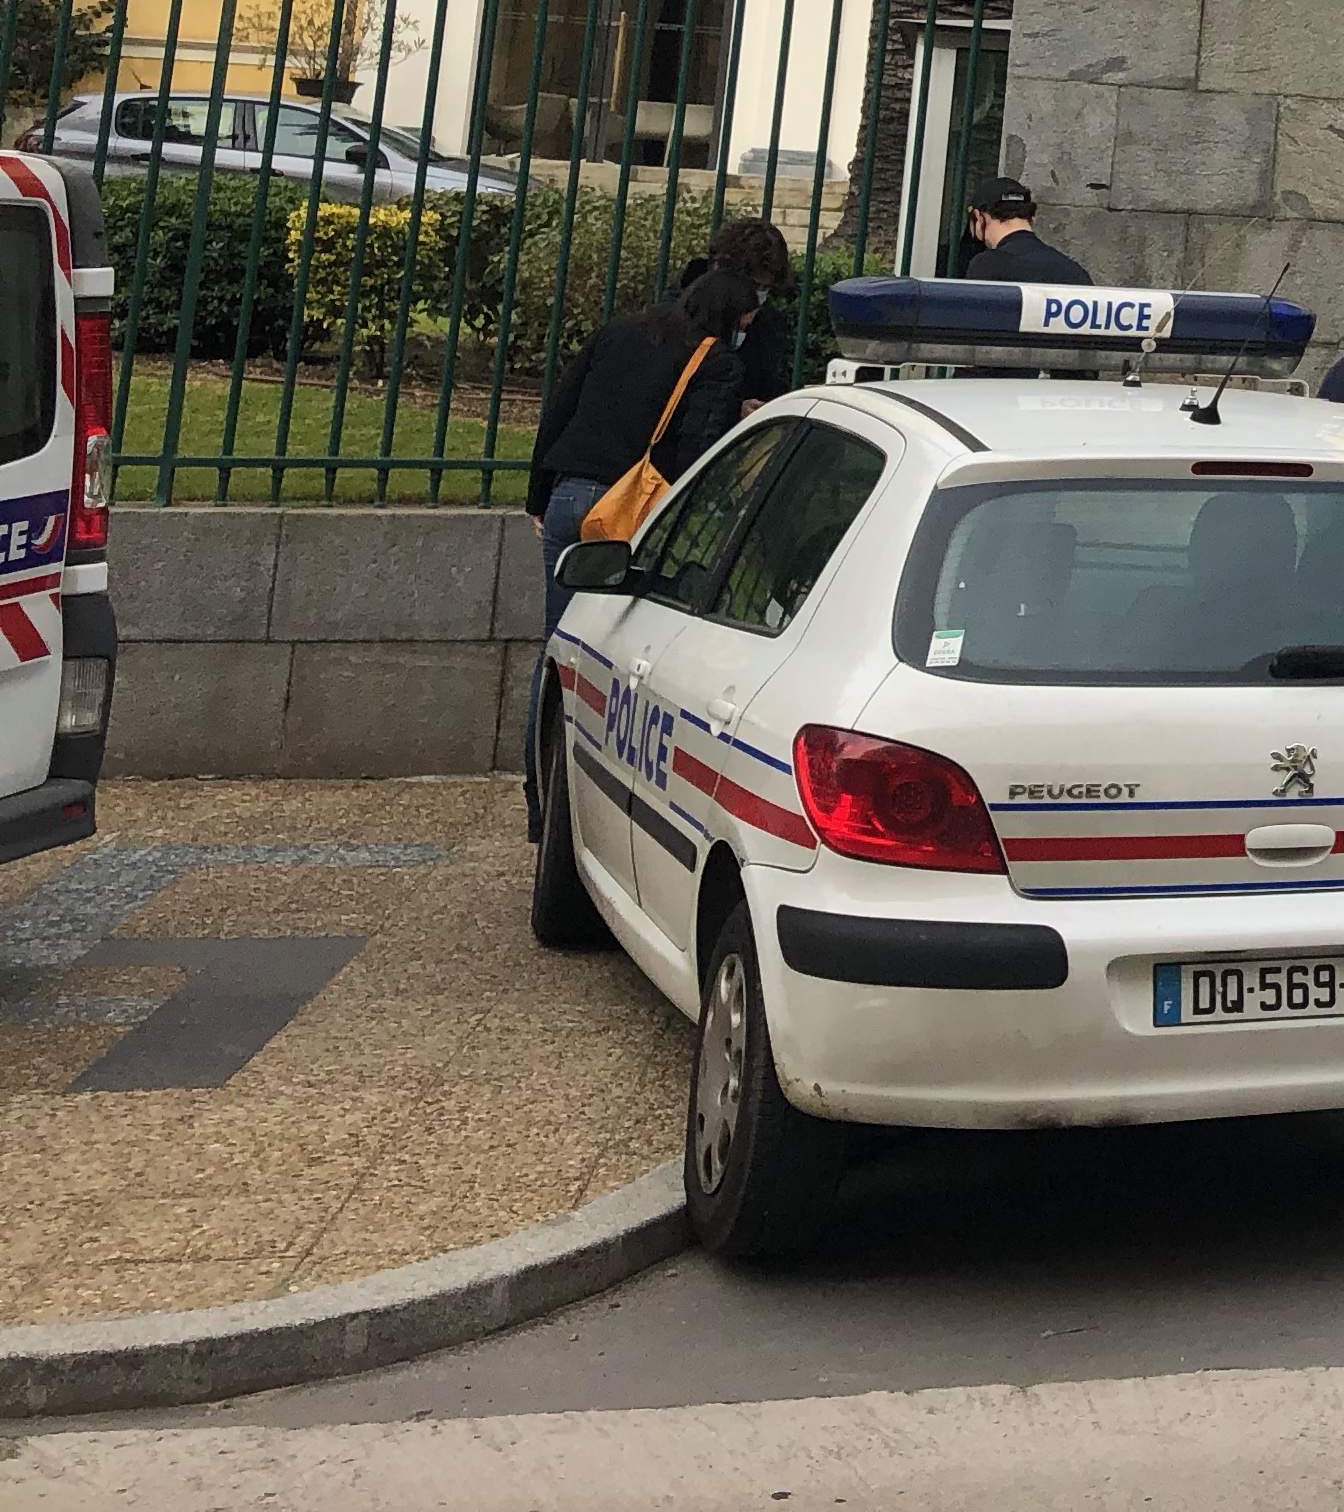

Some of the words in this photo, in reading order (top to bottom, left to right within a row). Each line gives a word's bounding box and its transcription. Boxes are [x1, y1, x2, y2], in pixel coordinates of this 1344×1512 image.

[1042, 297, 1152, 332] POLICE
[604, 677, 675, 792] POLICE
[1008, 782, 1141, 800] PEUGEOT
[1162, 999, 1173, 1014] F
